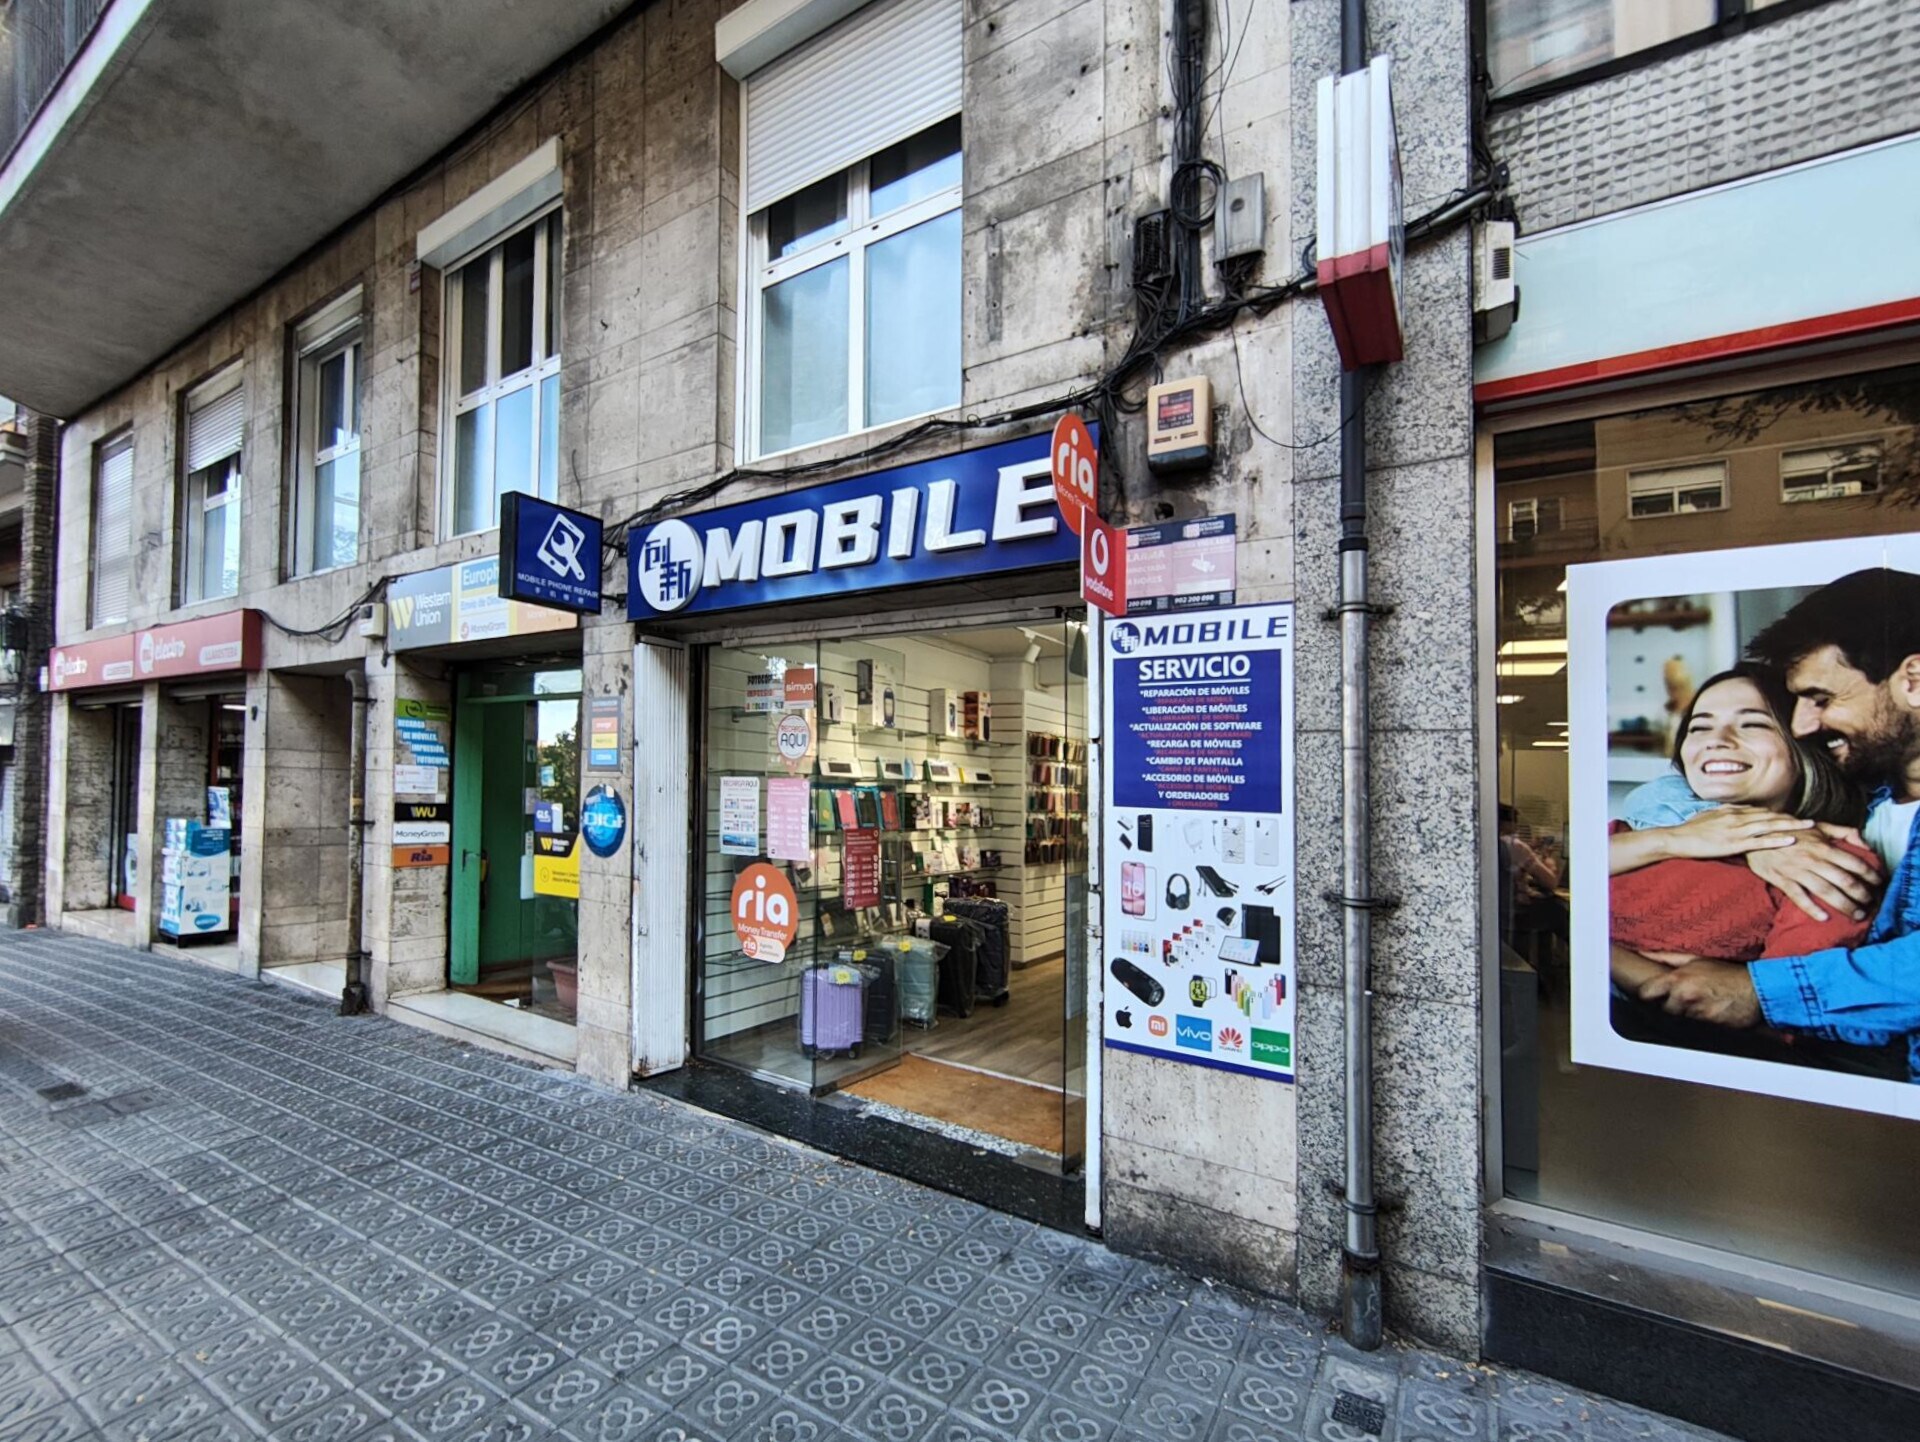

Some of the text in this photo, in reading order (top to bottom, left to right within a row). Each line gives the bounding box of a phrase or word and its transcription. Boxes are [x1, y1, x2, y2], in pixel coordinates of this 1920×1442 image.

[1058, 428, 1094, 499] ria
[702, 457, 1058, 588] MOBILE
[517, 572, 546, 587] MOBILE
[547, 580, 572, 593] PHONE
[573, 586, 599, 598] REPAIR
[1085, 575, 1114, 601] vodafone
[415, 592, 452, 608] Western
[415, 611, 442, 628] Union
[1144, 616, 1289, 647] MOBILE
[1139, 655, 1251, 681] SERVICIO
[786, 682, 814, 694] simyo
[1197, 687, 1210, 696] DE
[1211, 685, 1250, 695] MÓVILES
[1196, 705, 1207, 713] DE
[1208, 703, 1248, 713] MÓVILES
[1200, 722, 1212, 730] DE
[1213, 721, 1262, 731] SOFTWARE
[1190, 740, 1202, 748] DE
[1203, 738, 1242, 748] MÓVILES
[1184, 757, 1196, 766] DE
[1197, 757, 1243, 767] PANTALLA
[1193, 775, 1206, 783] DE
[1206, 773, 1246, 785] MÓVILES
[1165, 791, 1230, 801] ORDENADORES
[410, 806, 437, 818] WU
[583, 811, 623, 829] DIGI
[396, 829, 445, 839] MoneyGram
[411, 848, 433, 863] Ria
[1125, 881, 1142, 897] 16
[738, 874, 789, 927] ria
[737, 923, 788, 940] Money Transfer
[743, 937, 757, 950] ria
[1177, 1025, 1212, 1042] vivo
